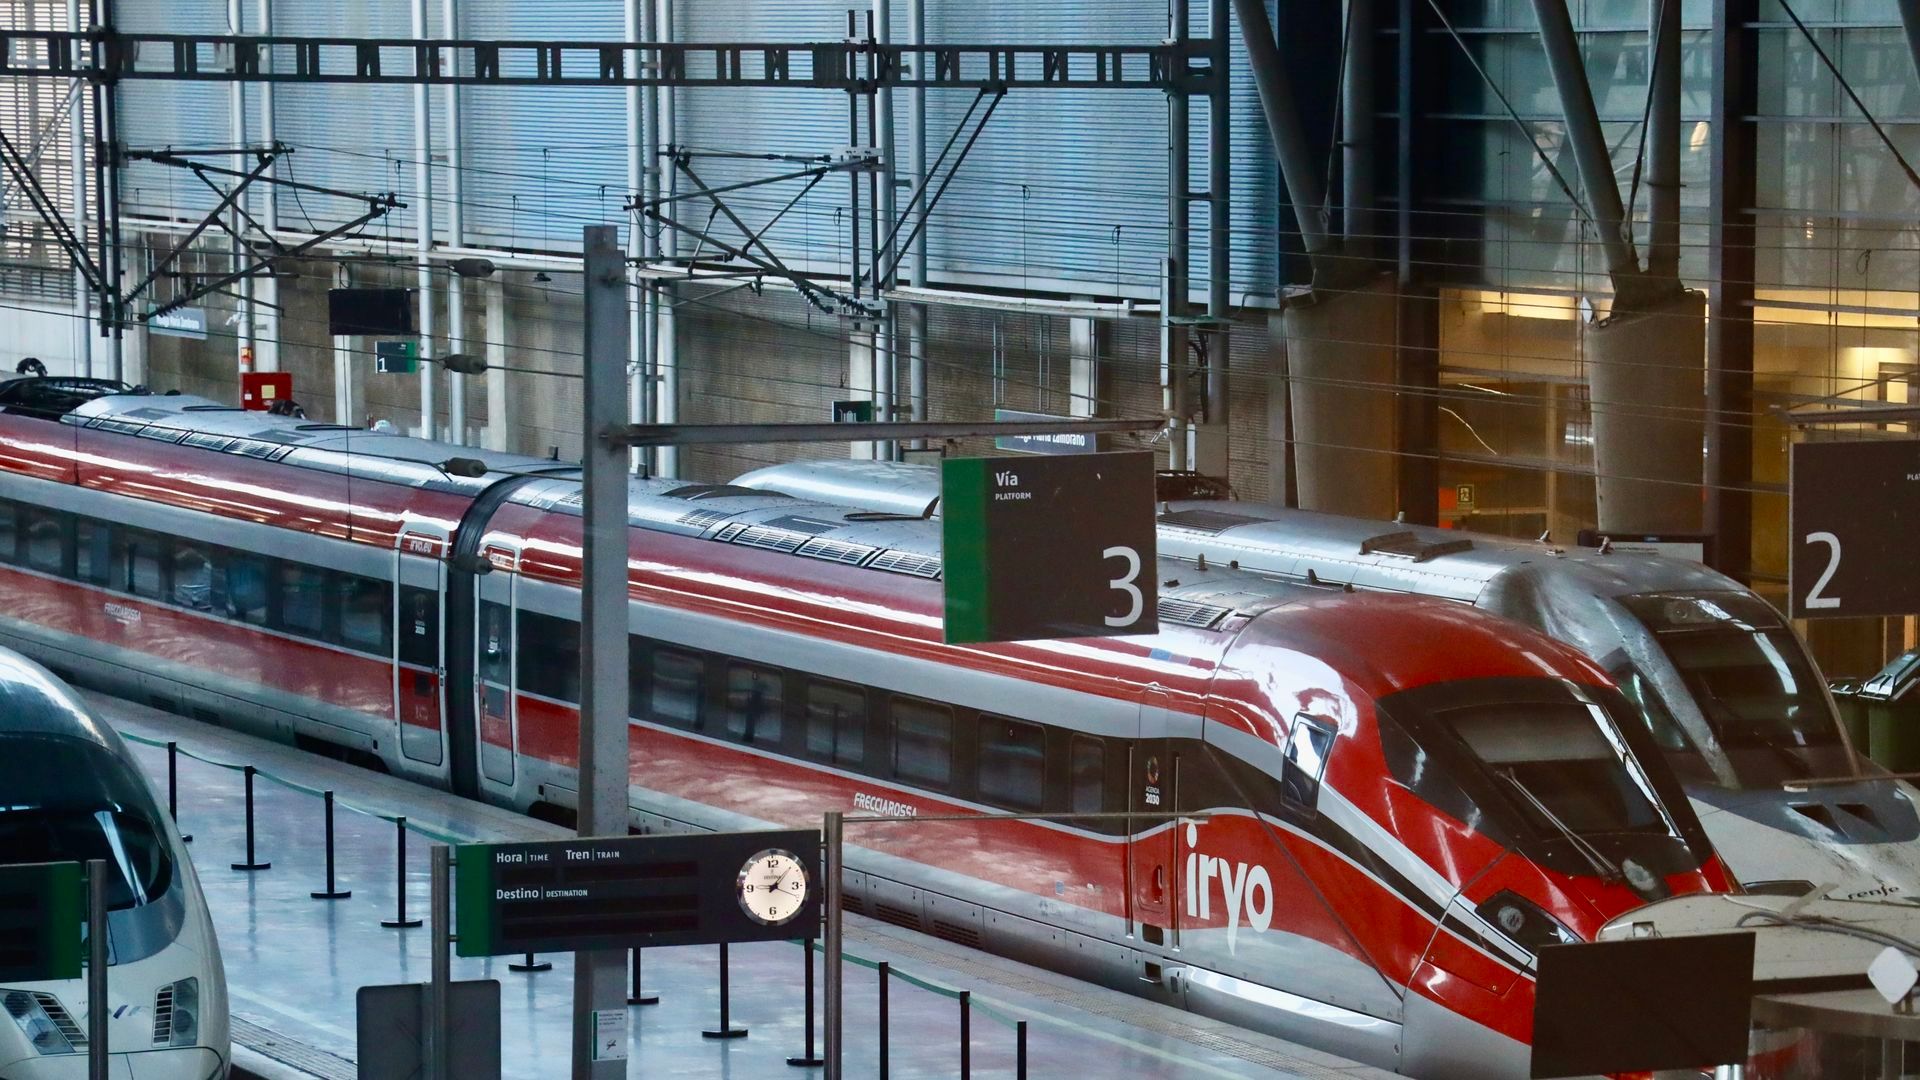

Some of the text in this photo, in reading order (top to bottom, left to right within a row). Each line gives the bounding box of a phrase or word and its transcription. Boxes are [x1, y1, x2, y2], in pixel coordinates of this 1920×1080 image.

[378, 357, 388, 372] 1
[995, 470, 1018, 486] Vía
[995, 492, 1032, 500] PLATFORM
[1805, 531, 1842, 609] 2
[1103, 545, 1143, 627] 3
[854, 792, 917, 816] FRECCIAROSSA
[1145, 793, 1160, 805] 2030
[496, 849, 620, 863] Hora TIME Tren TRAIN
[767, 860, 779, 868] 12
[746, 884, 754, 892] 9
[791, 881, 799, 890] 3
[1186, 823, 1273, 956] iryo
[496, 887, 588, 900] Destino DESTINATION
[1847, 886, 1899, 900] renfe
[769, 906, 777, 915] 6
